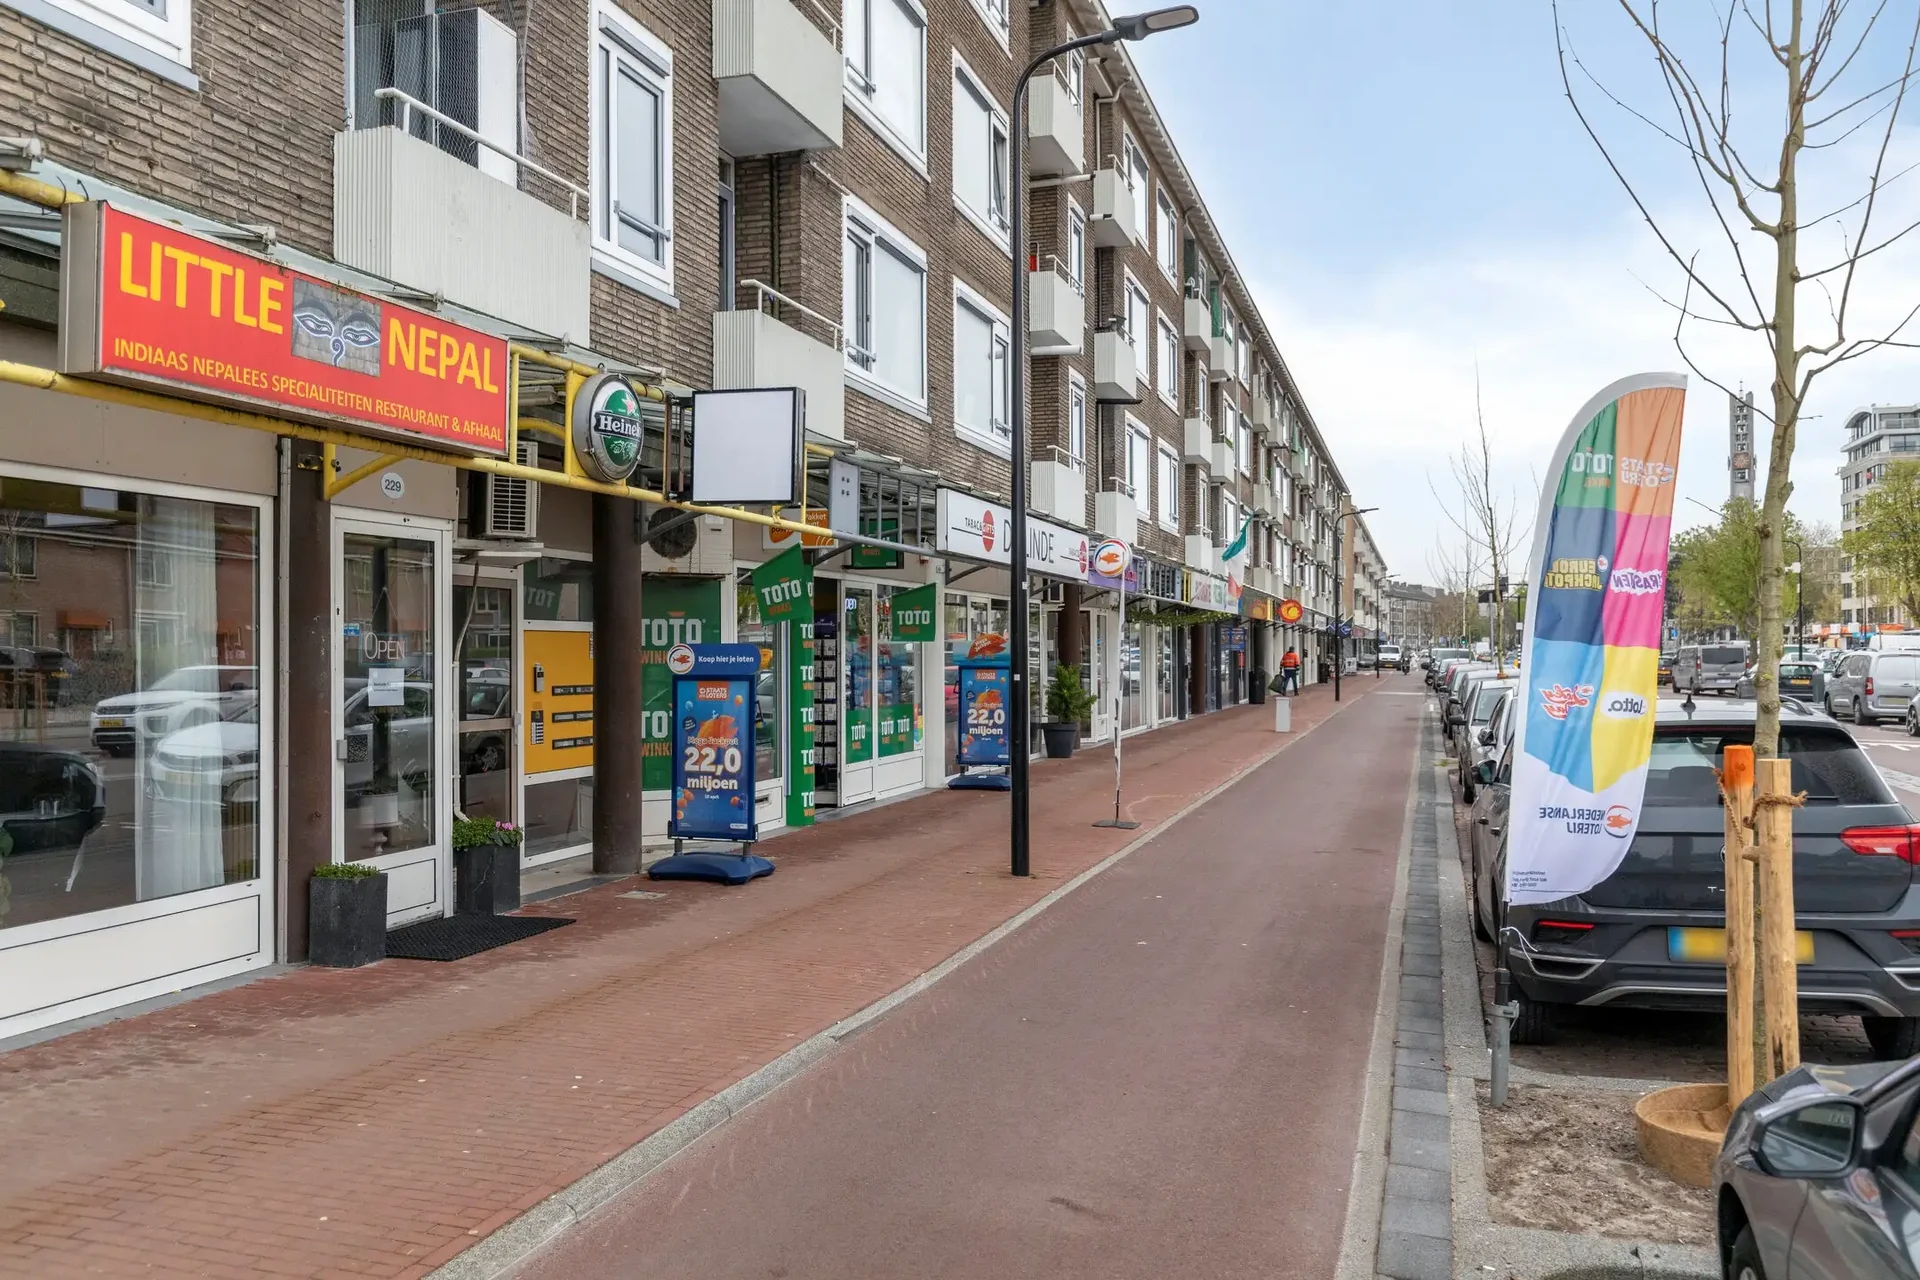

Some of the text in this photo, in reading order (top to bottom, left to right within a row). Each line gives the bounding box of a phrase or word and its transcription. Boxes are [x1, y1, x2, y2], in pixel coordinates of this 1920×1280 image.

[120, 231, 499, 394] LITTLE NEPAL
[114, 337, 502, 442] INDIAAS NEPALEES SPECIALITEITEN RESTAURANT & AFHAAL
[384, 479, 401, 492] 229
[1003, 519, 1012, 553] D
[1026, 527, 1054, 564] INDE
[761, 579, 802, 606] TOTO
[897, 610, 931, 625] TOTO
[641, 650, 667, 664] WINK
[698, 655, 754, 664] Koop hier je loten
[967, 708, 1006, 727] 22,0
[851, 724, 866, 741] TOTO
[969, 726, 1003, 738] miljoen
[641, 743, 672, 756] WINK
[684, 746, 742, 775] 22,0
[687, 776, 738, 792] miljoen
